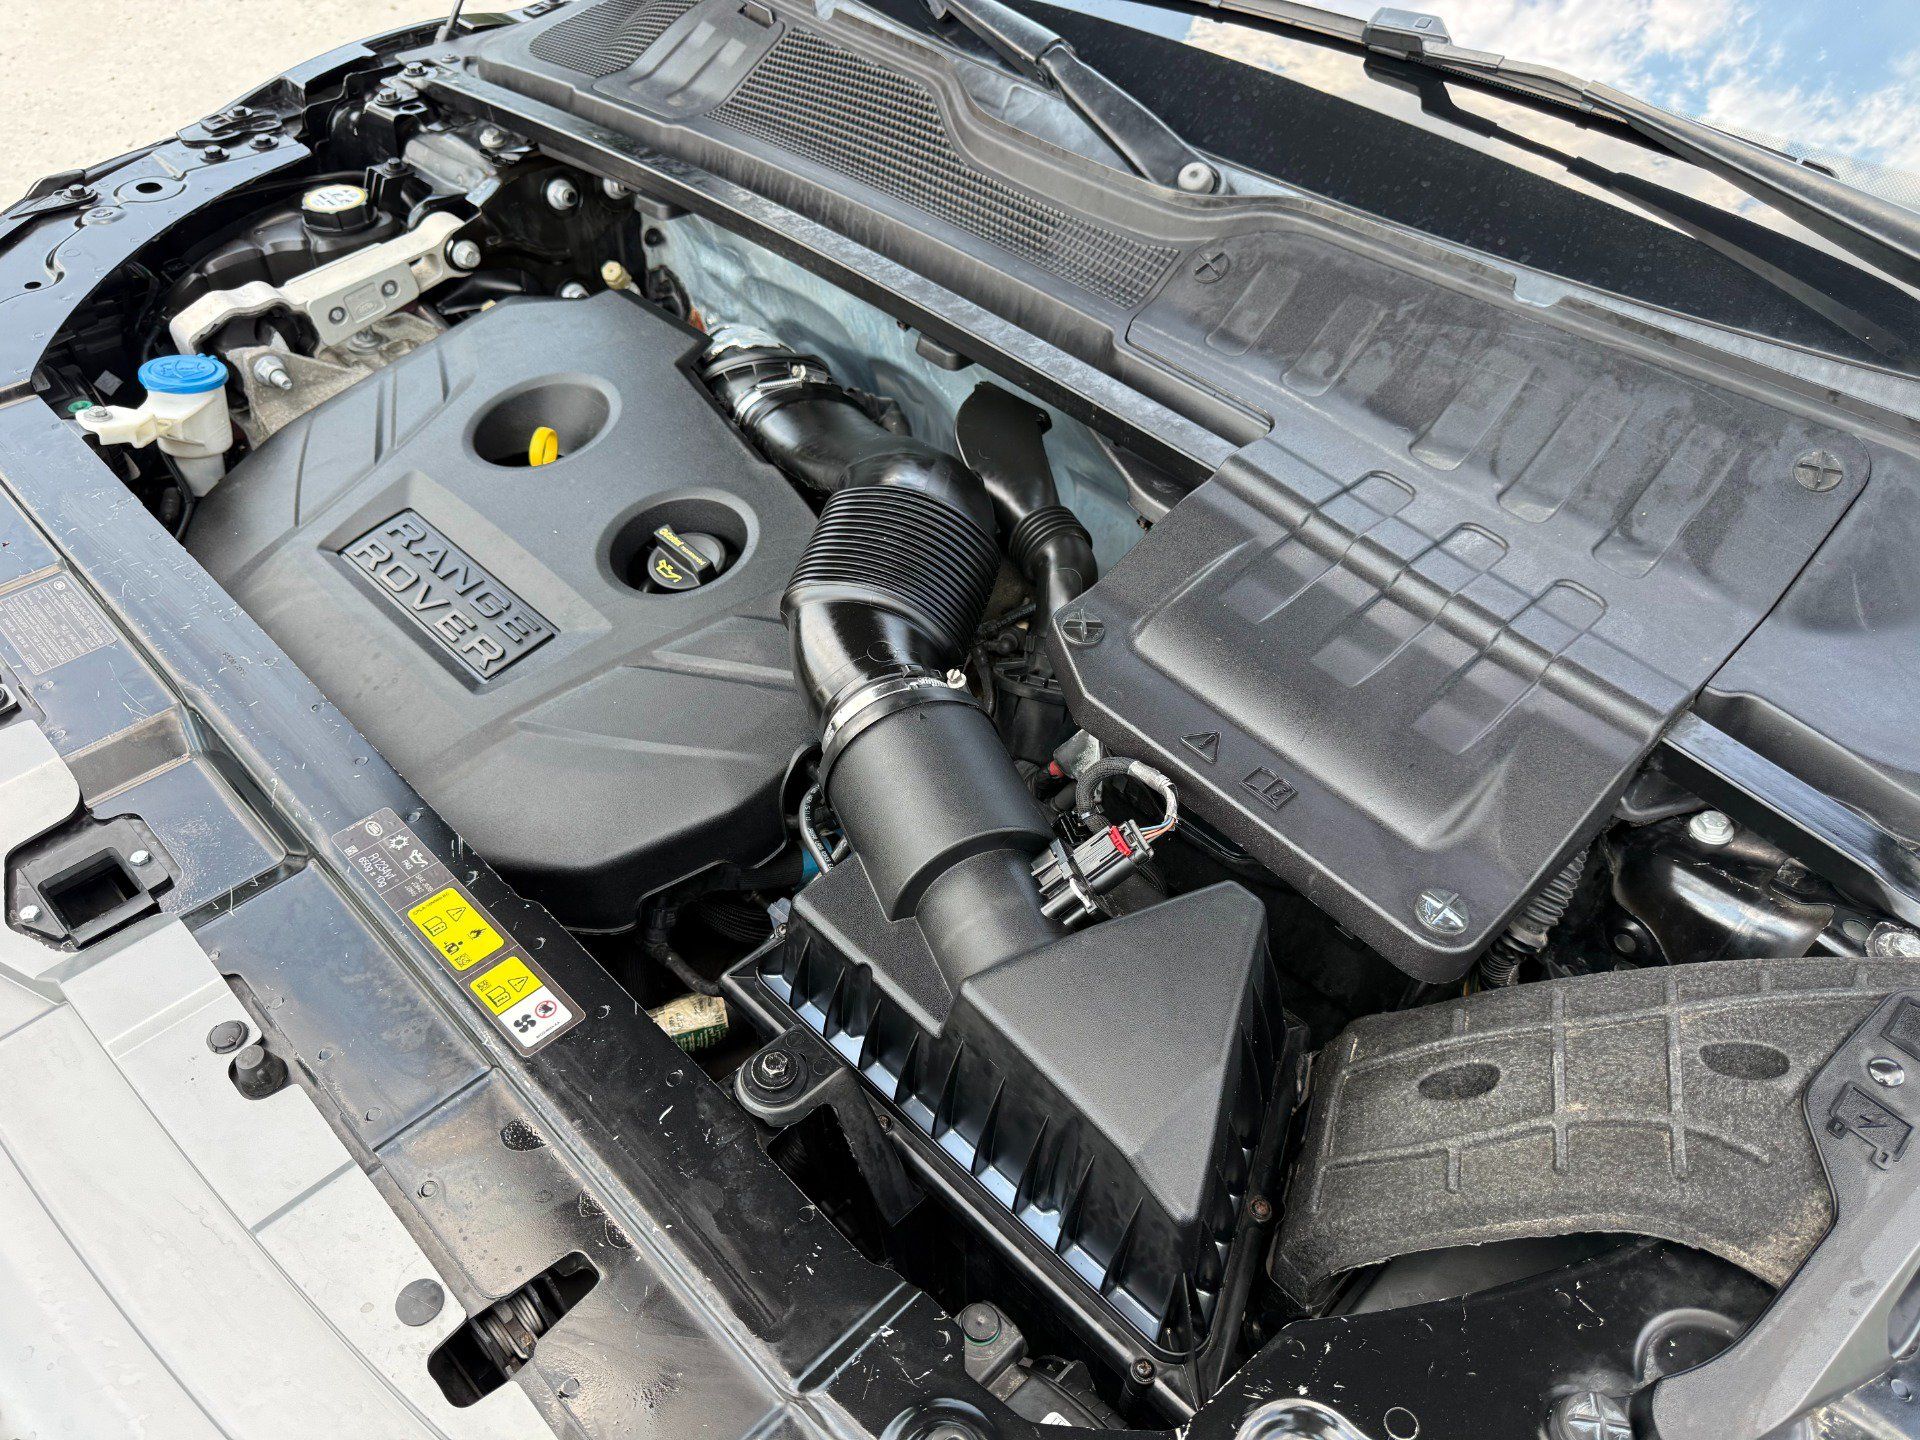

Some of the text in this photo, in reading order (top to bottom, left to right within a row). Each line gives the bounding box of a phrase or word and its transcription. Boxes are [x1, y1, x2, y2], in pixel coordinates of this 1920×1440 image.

[353, 538, 506, 671] ROVER
[387, 522, 542, 643] RANGE
[358, 856, 374, 873] 650g
[375, 875, 387, 888] 10g
[402, 859, 414, 870] PAG
